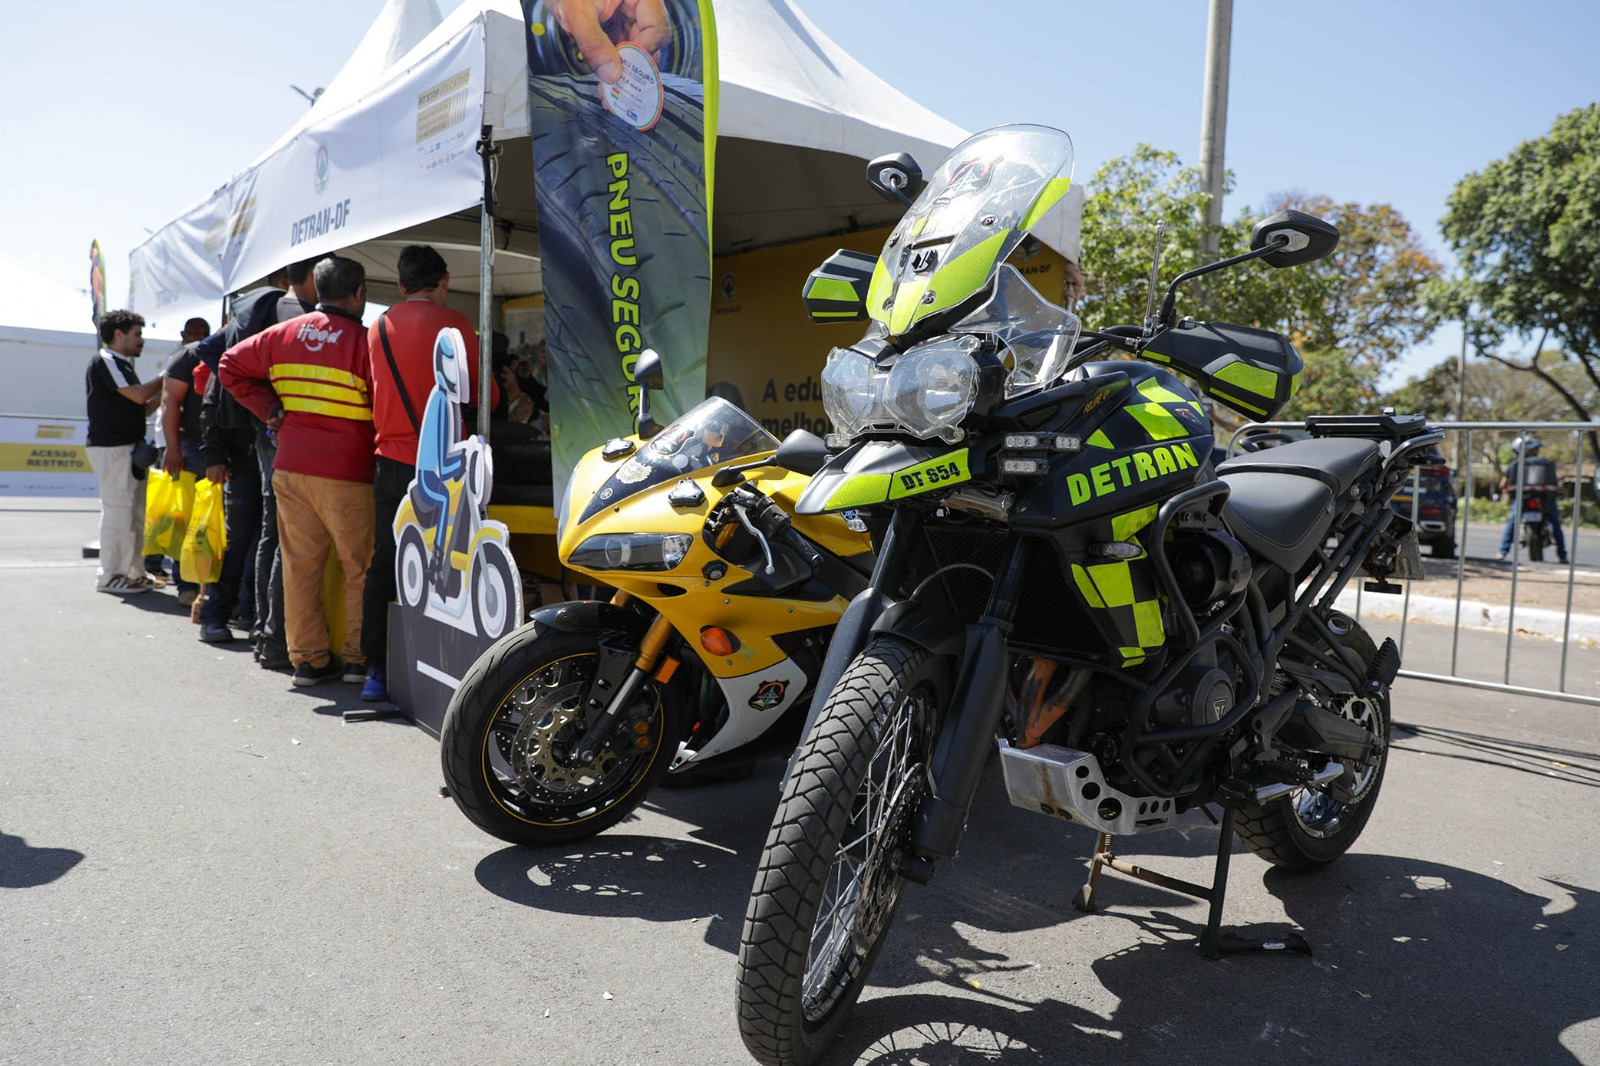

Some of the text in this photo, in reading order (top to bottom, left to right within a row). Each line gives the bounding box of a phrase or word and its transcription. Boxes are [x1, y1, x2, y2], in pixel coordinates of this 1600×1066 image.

[606, 151, 637, 266] PNEU
[290, 198, 351, 247] DETRAN-DF
[763, 378, 777, 402] A
[26, 458, 84, 468] RESTRITO
[31, 449, 77, 458] ACESSO
[901, 472, 924, 490] DT
[1066, 443, 1199, 507] DETRAN
